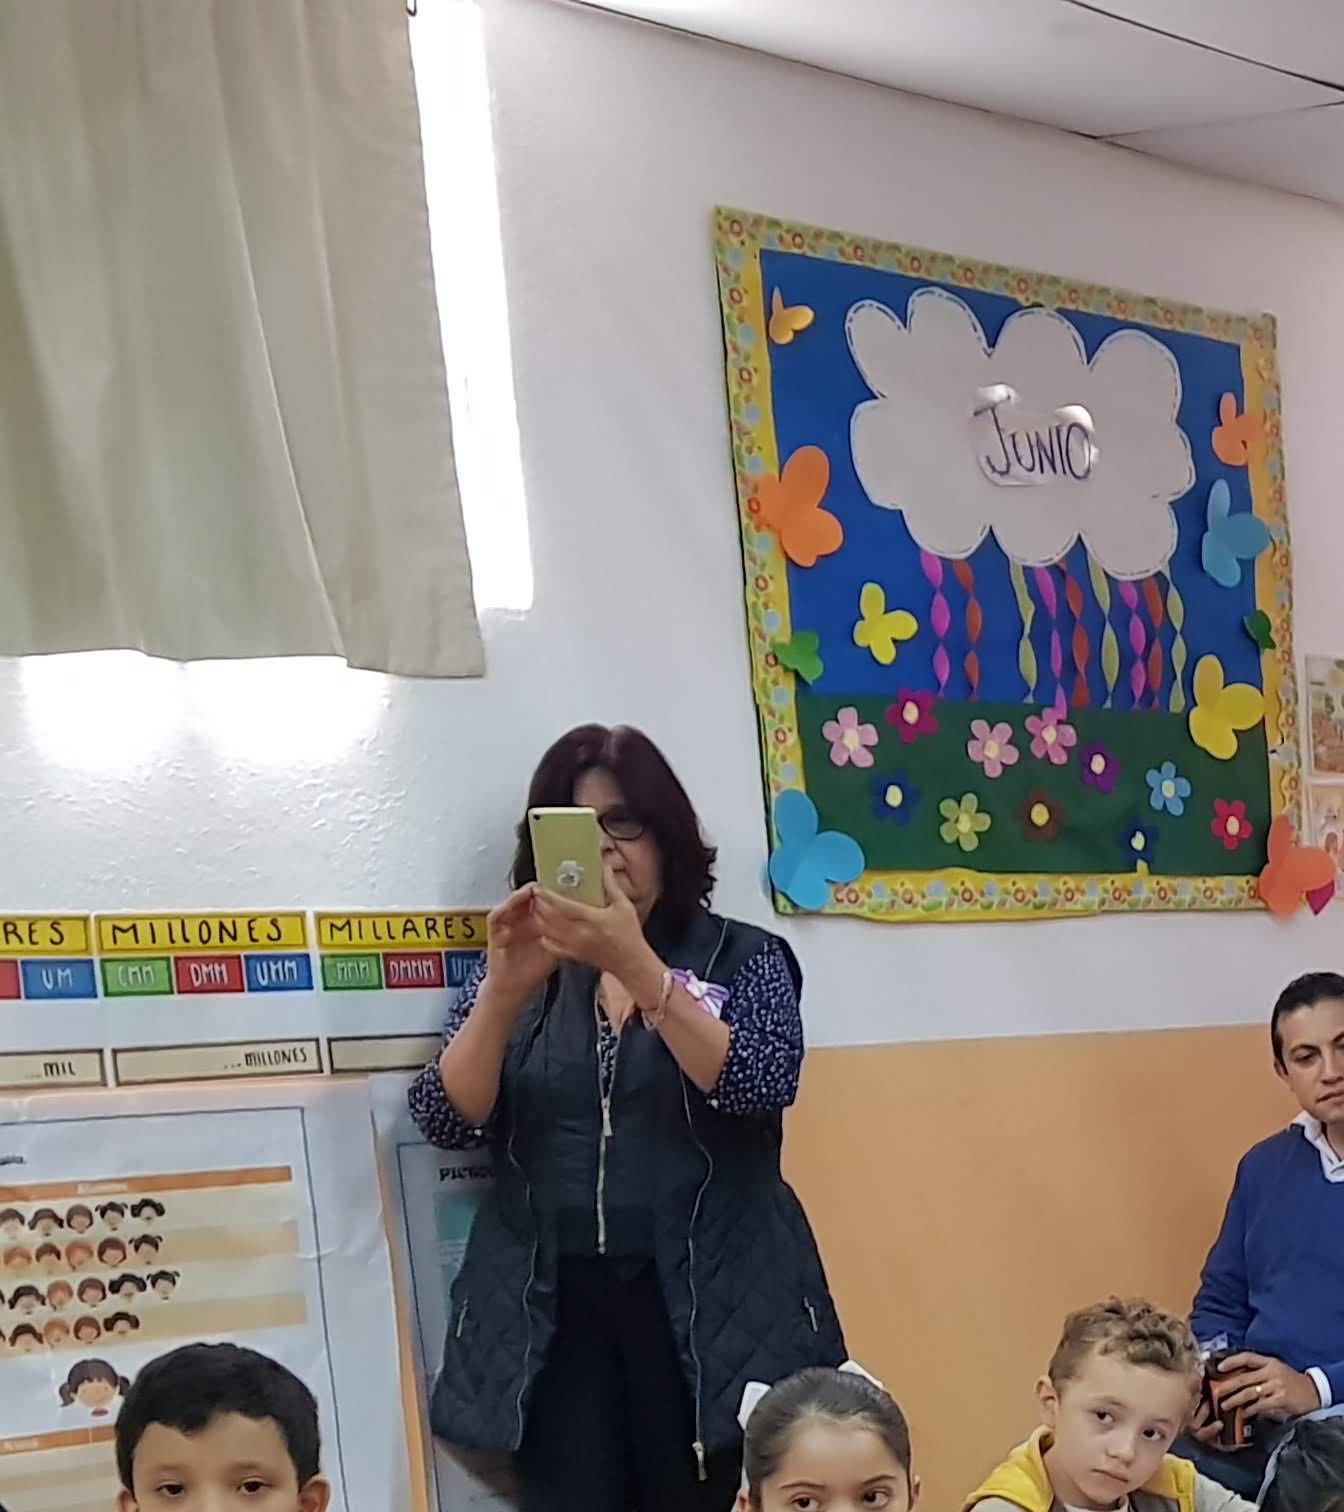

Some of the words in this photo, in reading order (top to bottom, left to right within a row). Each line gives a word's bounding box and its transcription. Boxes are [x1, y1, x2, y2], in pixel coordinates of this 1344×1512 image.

[973, 400, 1092, 481] JUNIO
[112, 918, 281, 944] MILLONES
[330, 917, 475, 941] MILLARES
[41, 967, 73, 990] UM
[190, 962, 228, 987] DMM
[256, 960, 298, 986] UMM
[389, 958, 435, 978] DMMM
